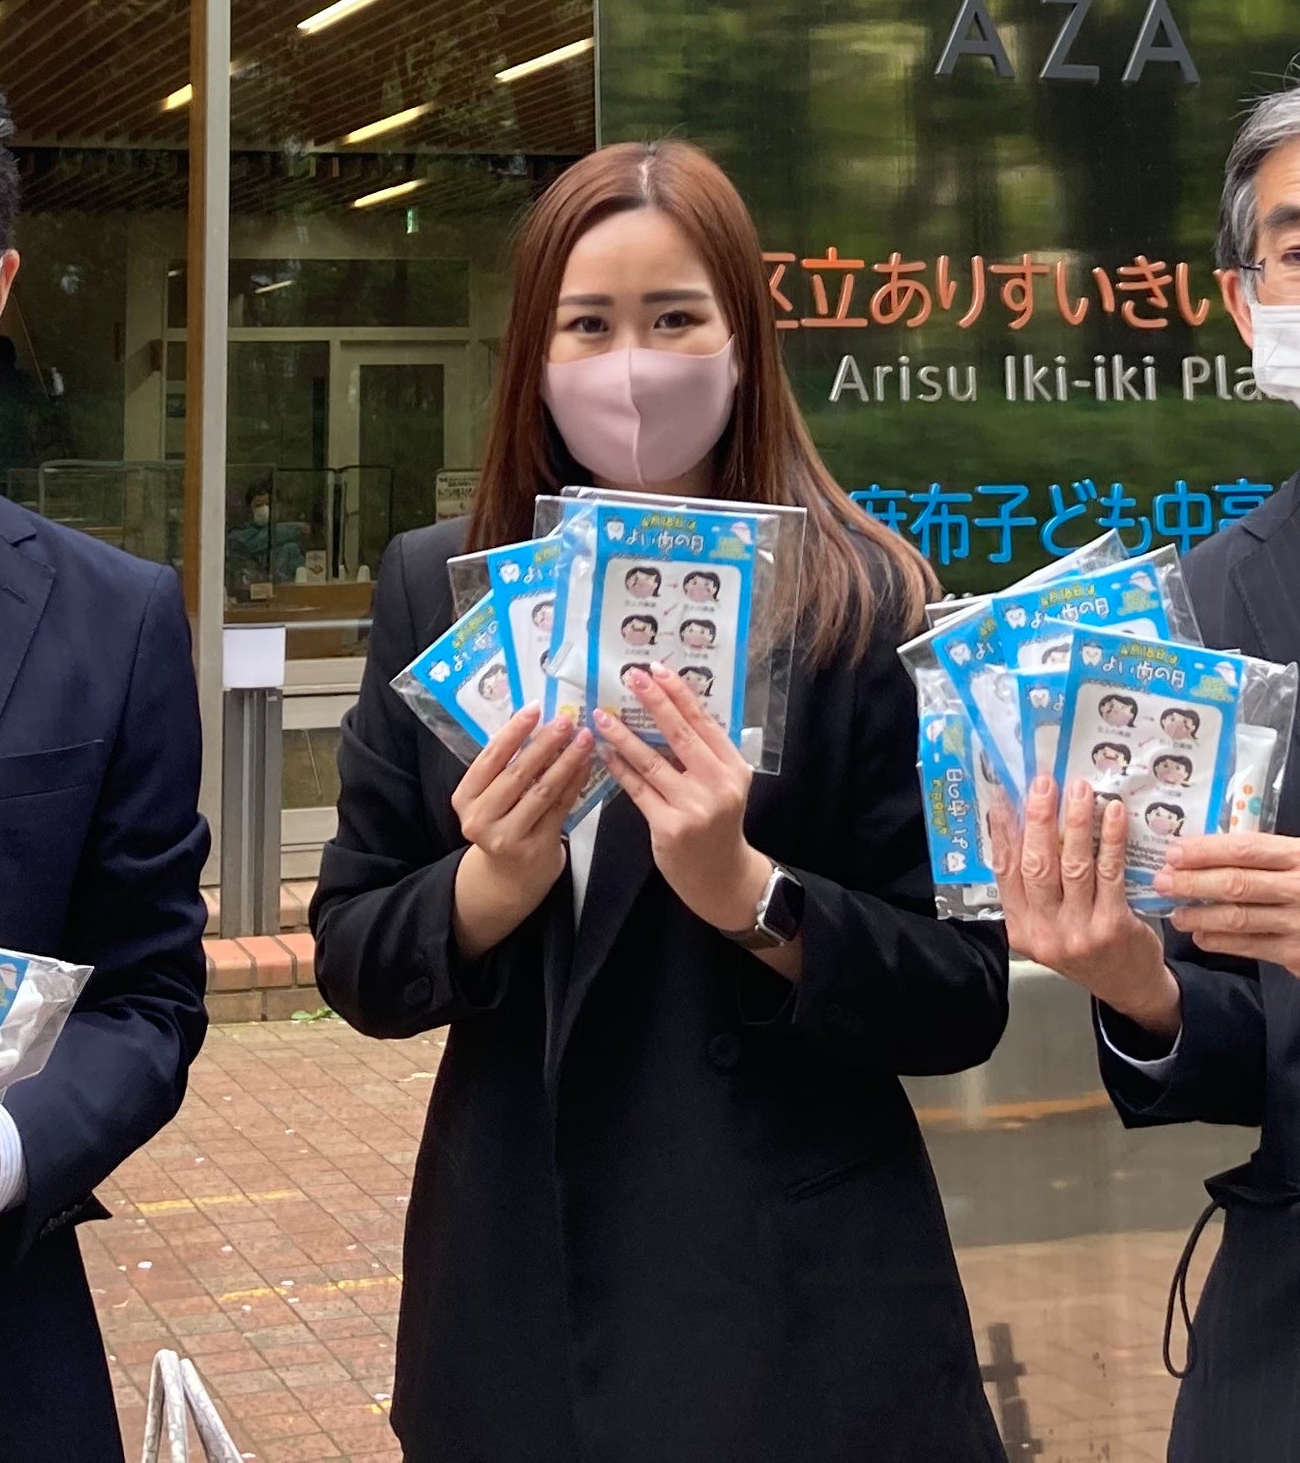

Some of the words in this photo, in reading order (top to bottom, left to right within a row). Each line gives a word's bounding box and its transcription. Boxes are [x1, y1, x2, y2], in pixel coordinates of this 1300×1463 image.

[828, 354, 978, 403] Arisu
[1004, 354, 1158, 402] Iki-iki
[1102, 655, 1186, 690] よい歯の日
